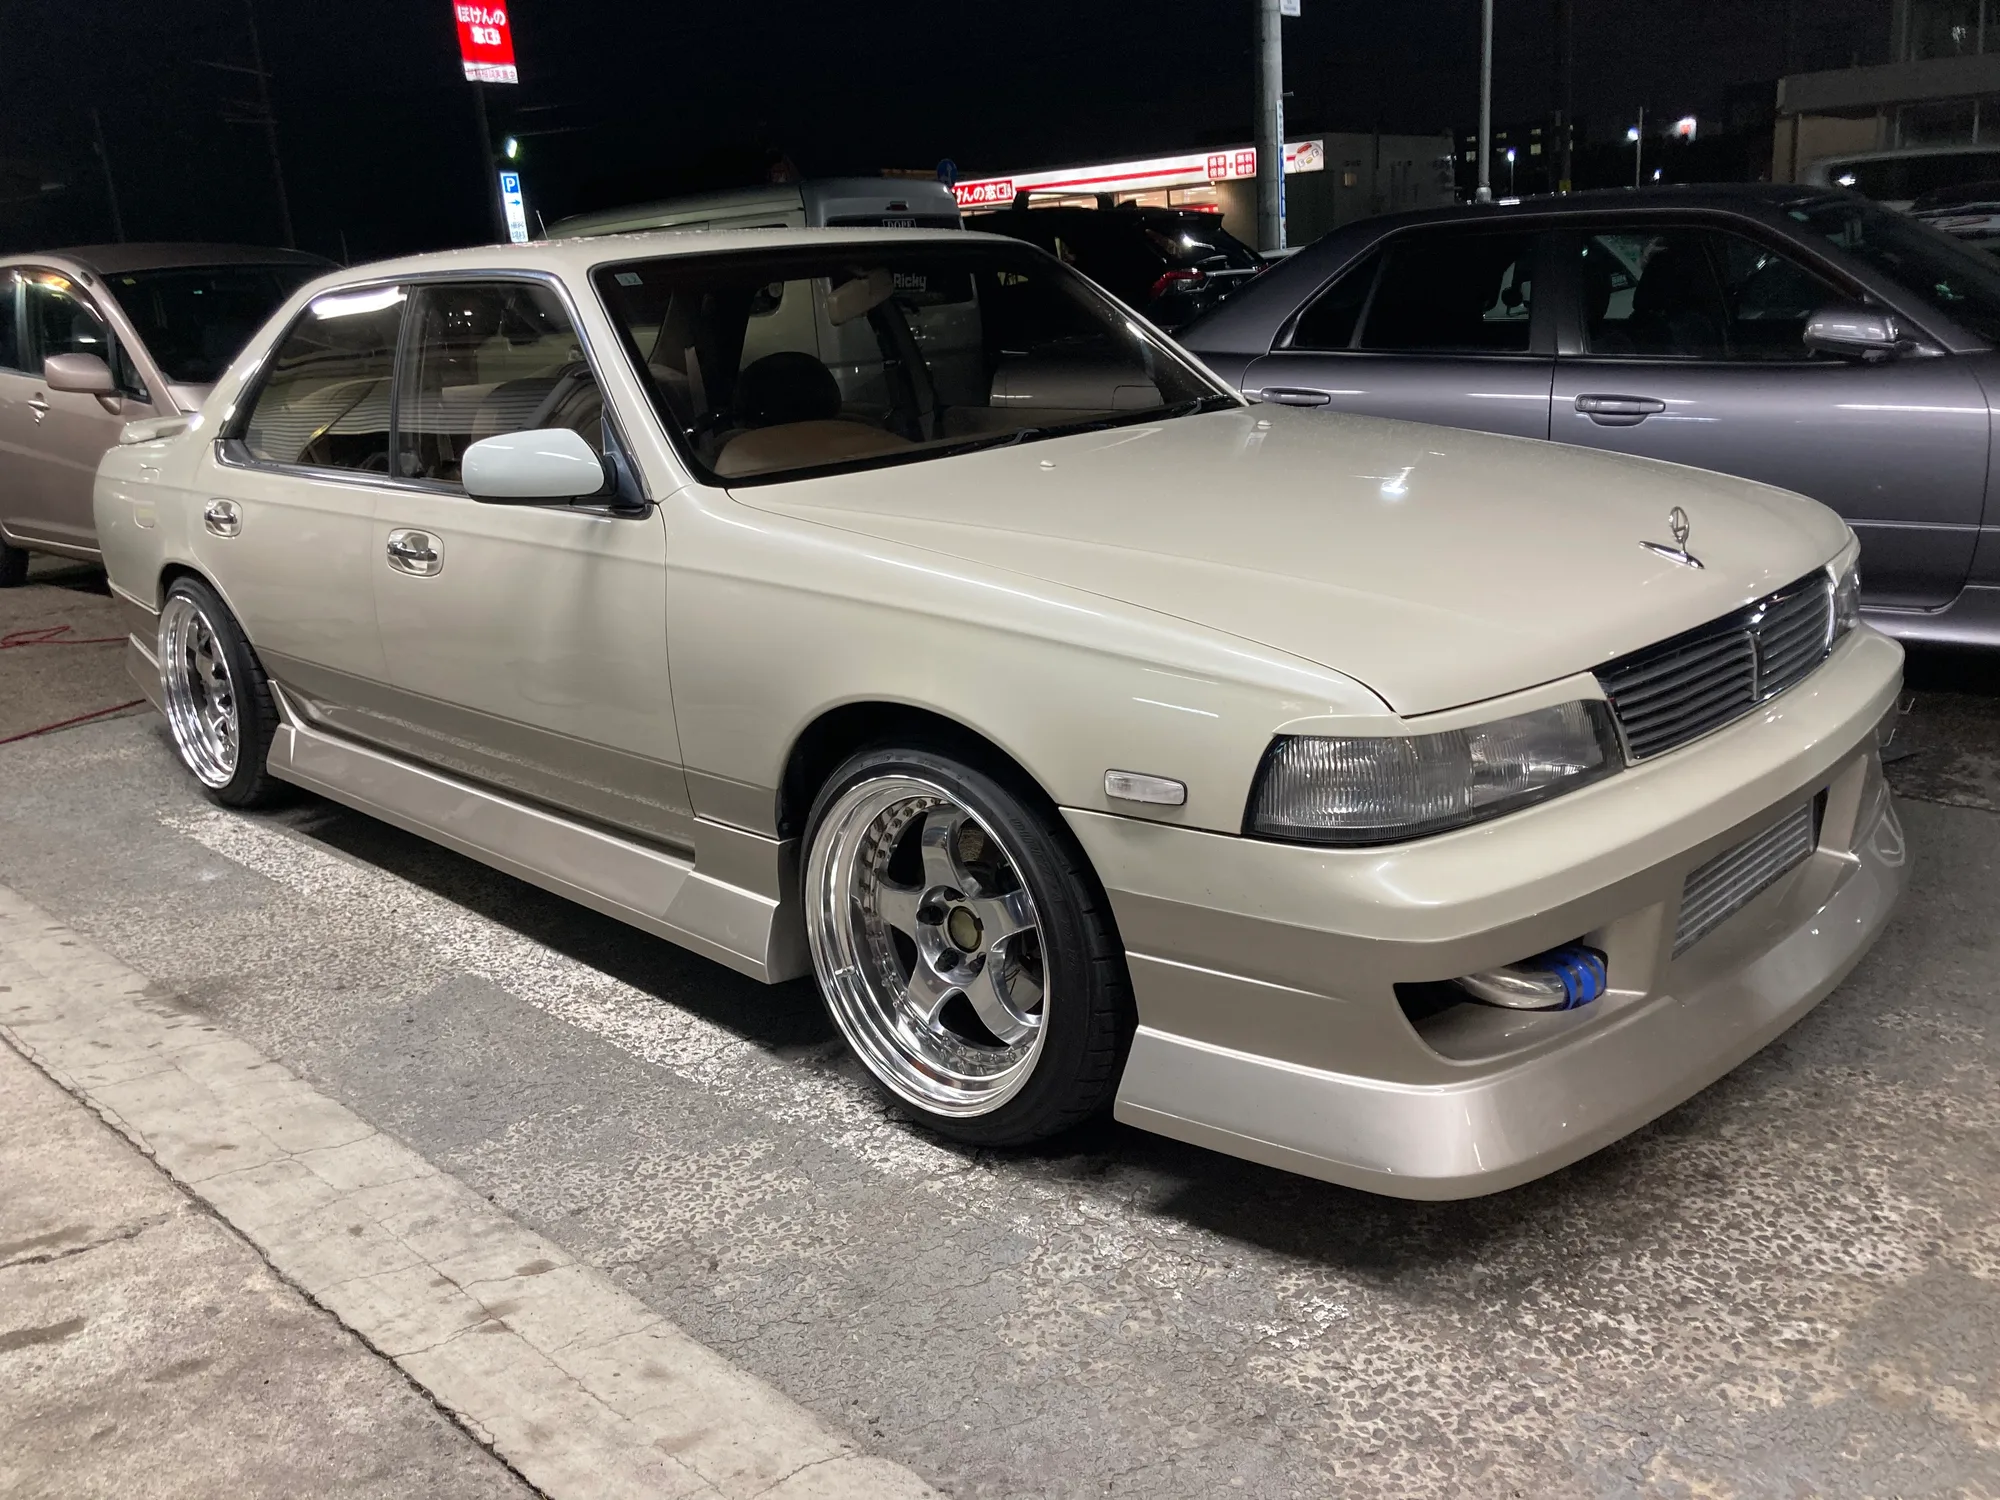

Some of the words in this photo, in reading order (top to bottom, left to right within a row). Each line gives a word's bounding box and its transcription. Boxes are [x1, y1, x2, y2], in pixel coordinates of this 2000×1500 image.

[457, 5, 506, 26] ほけんの
[505, 177, 516, 192] P
